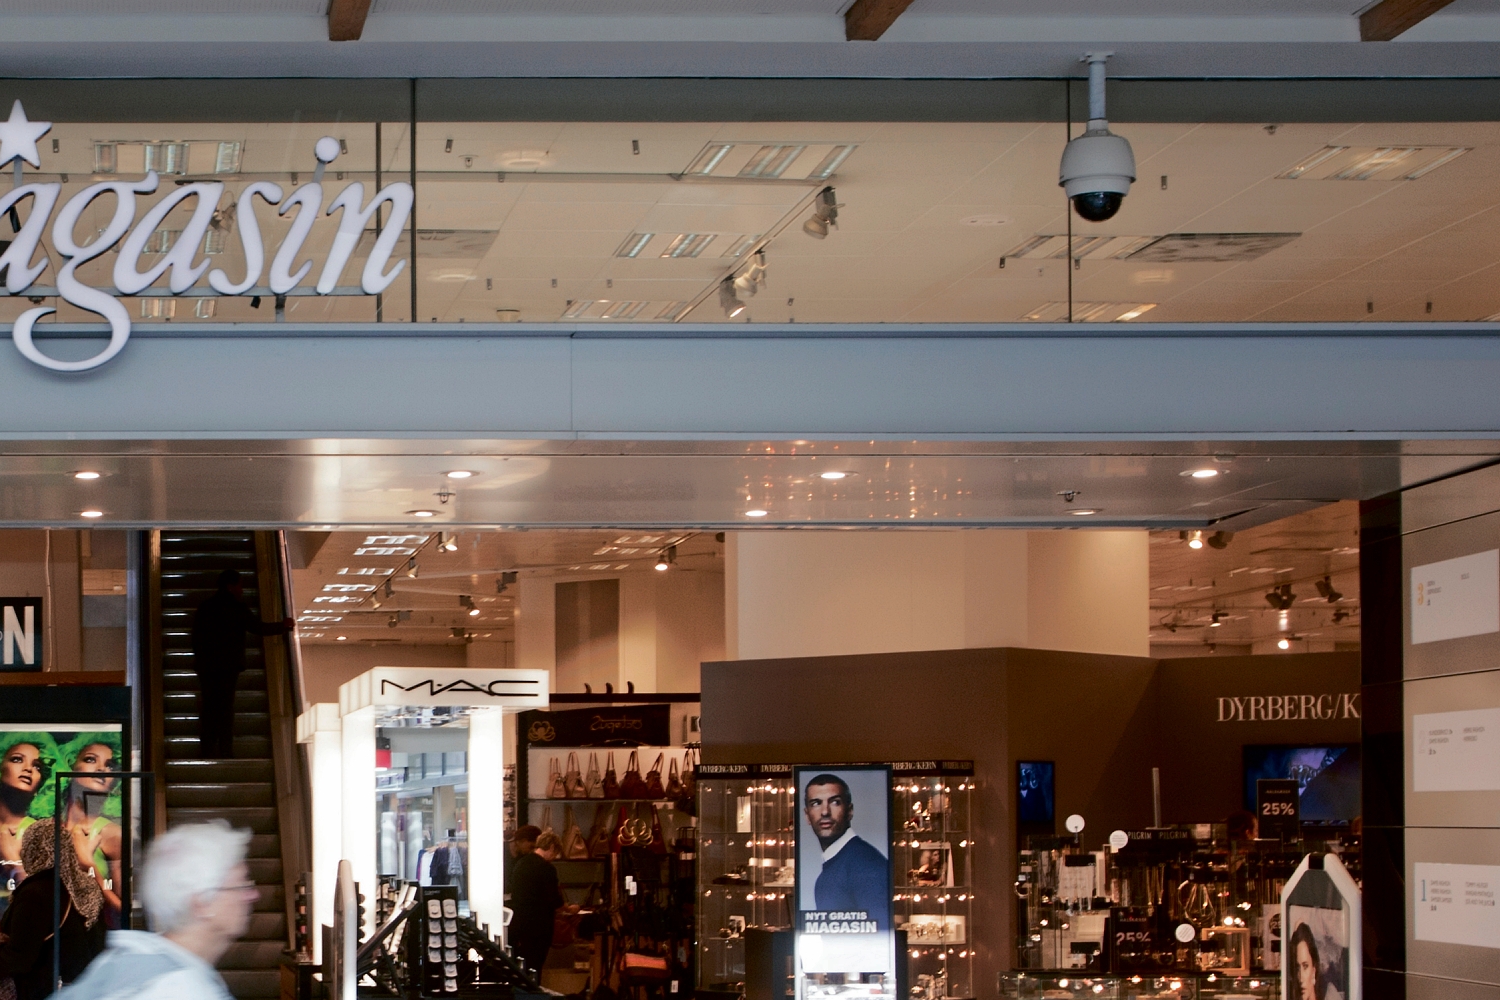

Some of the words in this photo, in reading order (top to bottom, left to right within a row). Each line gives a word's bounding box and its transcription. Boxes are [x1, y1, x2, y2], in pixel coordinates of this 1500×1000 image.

[1216, 692, 1361, 722] DYRBERG/K
[761, 764, 792, 773] DYRBERG
[892, 761, 937, 770] RBERG/KERN
[1262, 803, 1295, 816] 25%
[1127, 831, 1152, 840] PILGRIM
[1159, 831, 1188, 840] PILGRIM
[805, 912, 828, 920] NYT
[829, 911, 867, 920] GRATIS
[805, 921, 878, 933] MAGASIN
